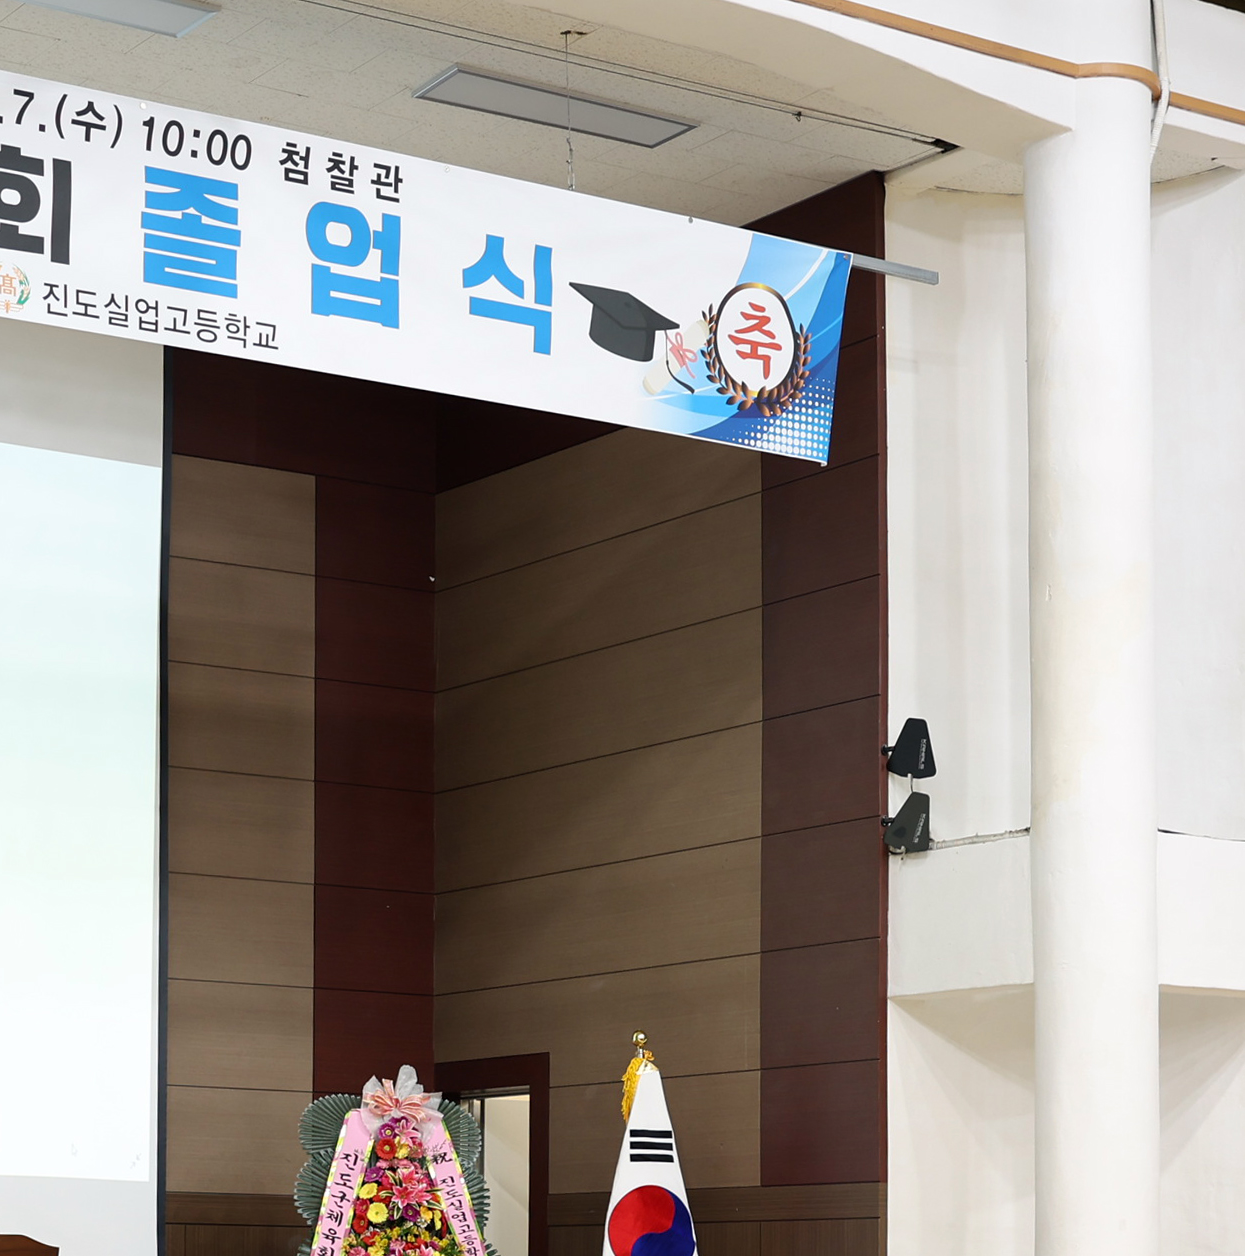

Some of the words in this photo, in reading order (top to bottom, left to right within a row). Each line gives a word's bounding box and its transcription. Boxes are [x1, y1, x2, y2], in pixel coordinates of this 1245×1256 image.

[141, 115, 253, 171] 10:00
[41, 281, 280, 351] 진도실업고등학교
[727, 301, 783, 381] 축
